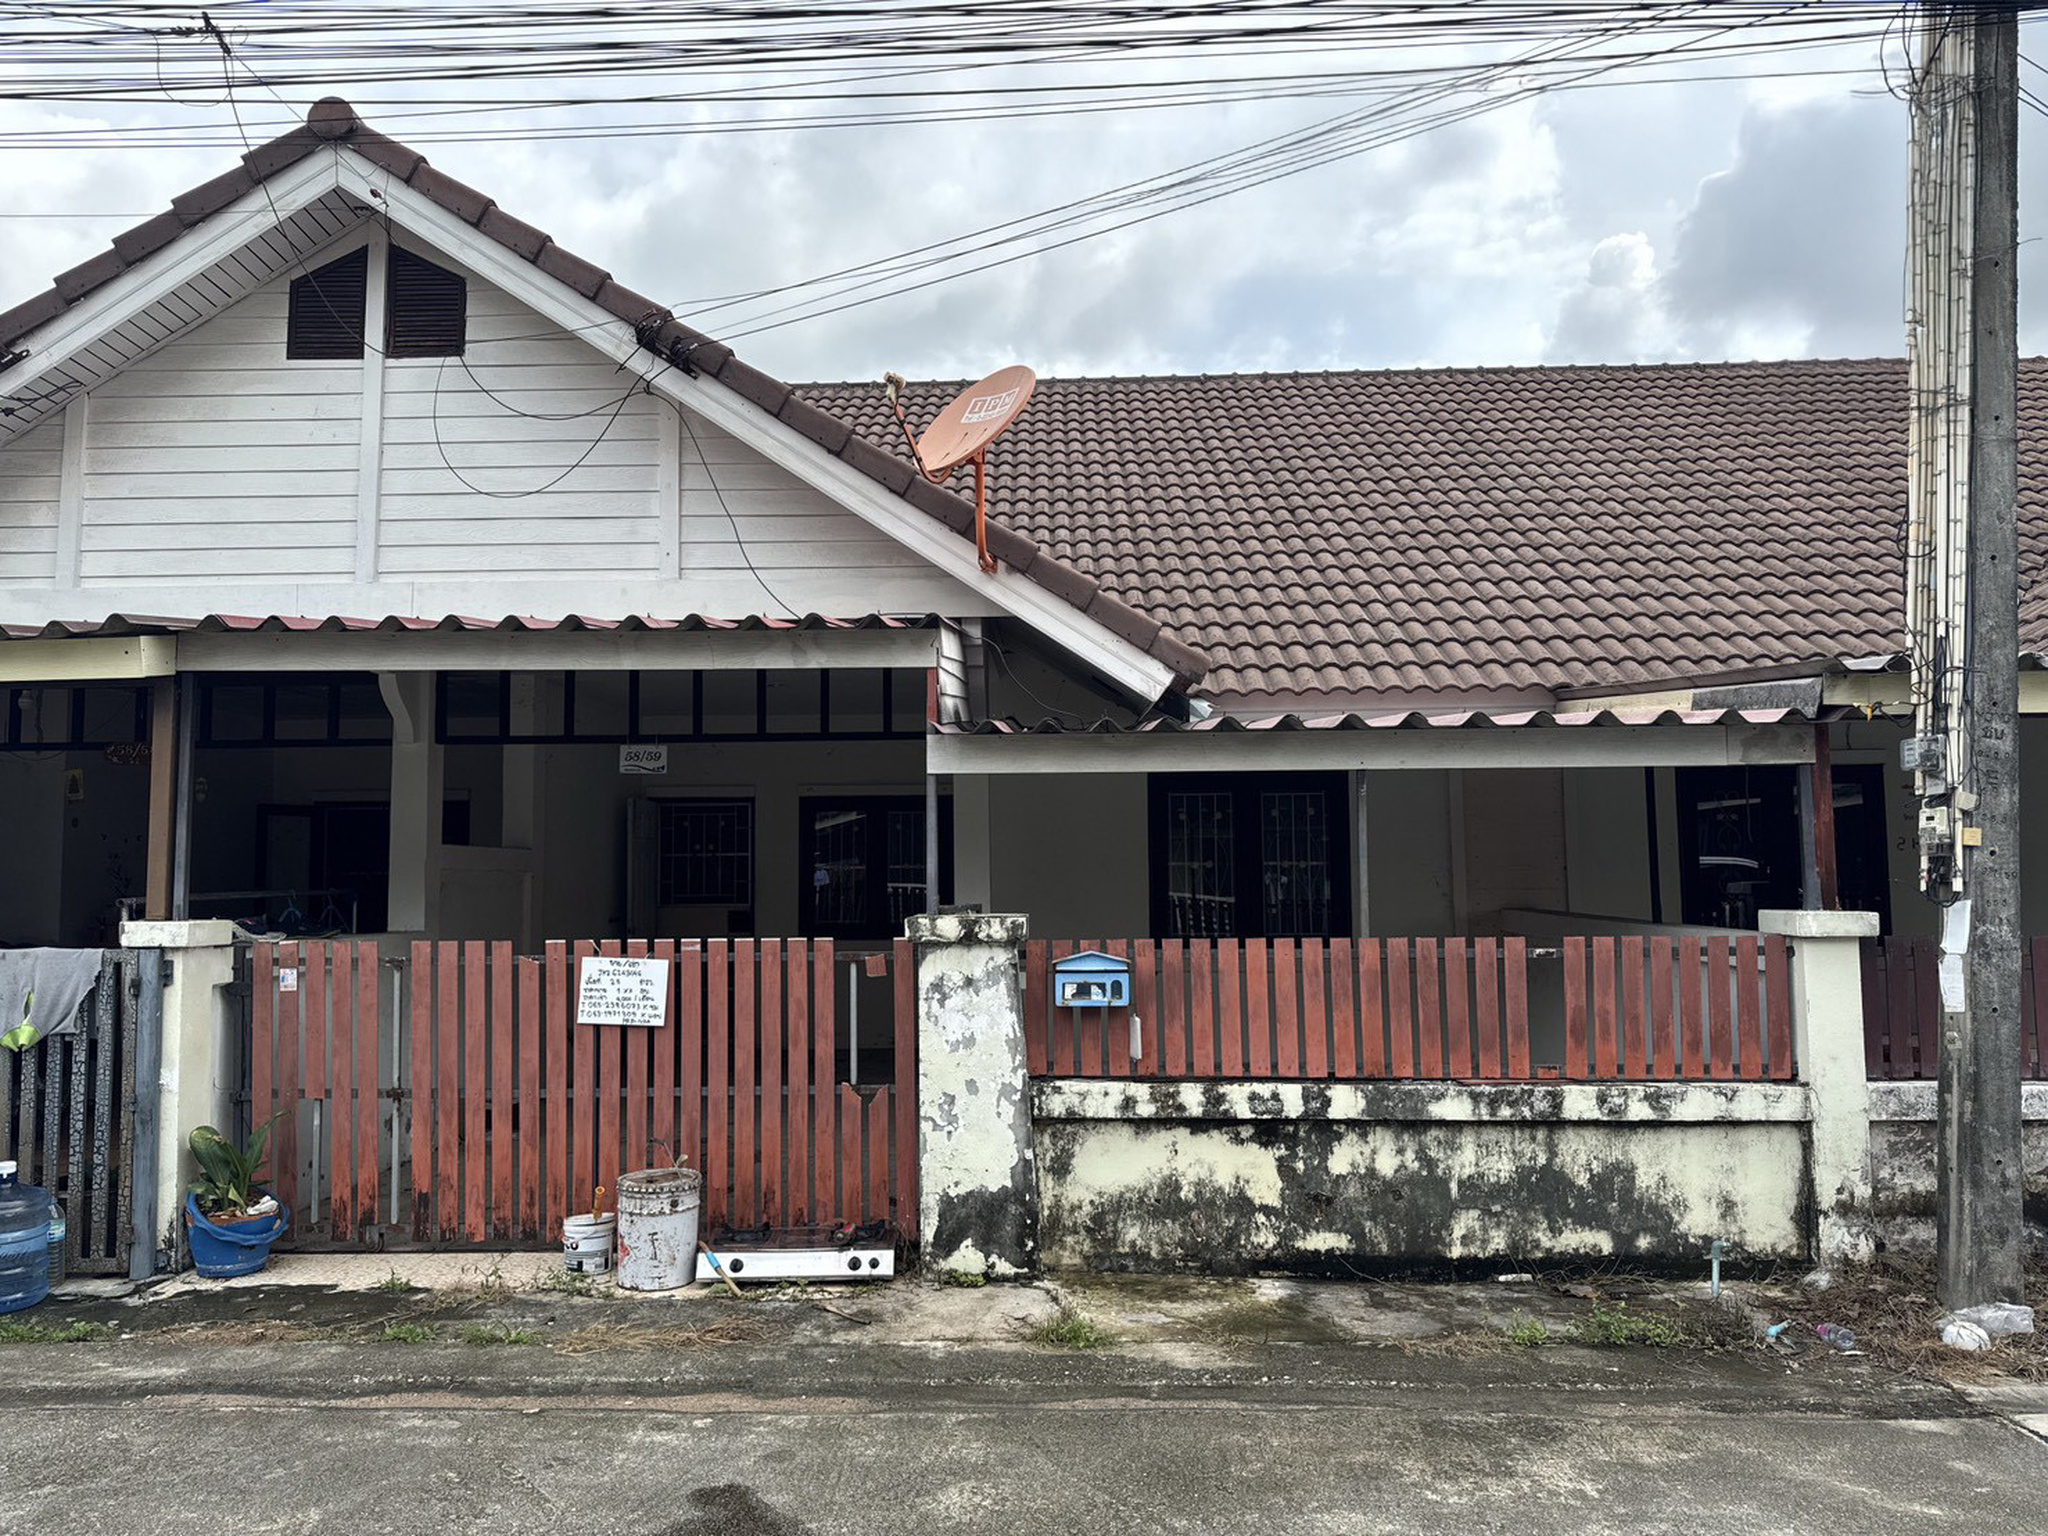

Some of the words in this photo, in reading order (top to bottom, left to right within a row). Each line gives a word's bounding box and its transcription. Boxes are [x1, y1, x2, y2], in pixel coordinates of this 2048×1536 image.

[971, 391, 1016, 412] IPM
[117, 743, 151, 758] 58/5
[625, 750, 662, 762] 58/59
